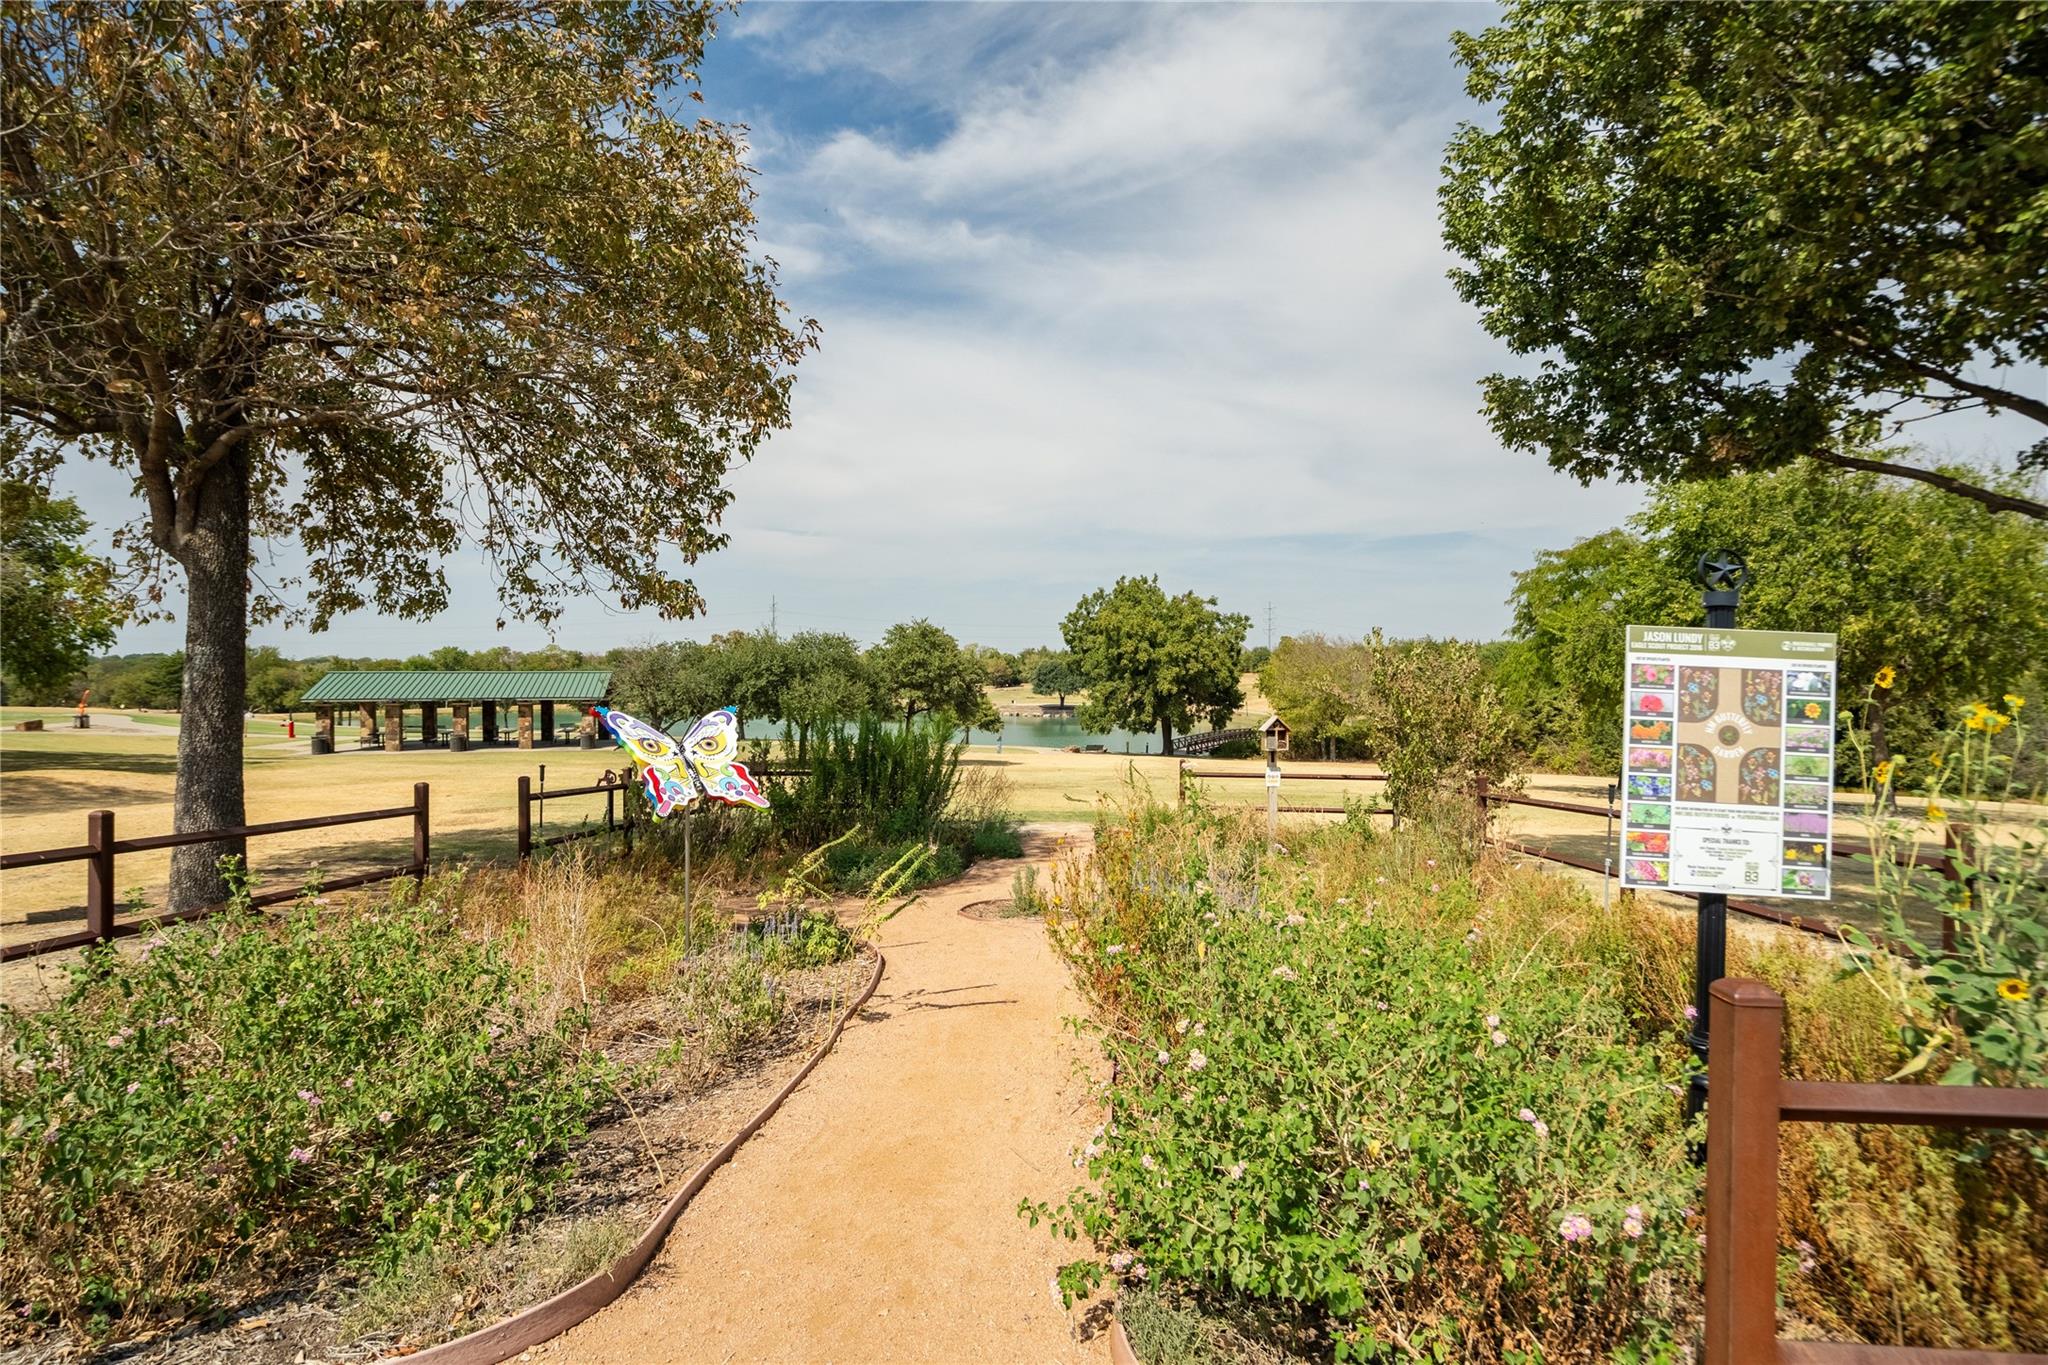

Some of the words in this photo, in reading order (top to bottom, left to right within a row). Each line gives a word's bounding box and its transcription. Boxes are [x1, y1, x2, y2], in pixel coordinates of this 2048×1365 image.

[1643, 631, 1672, 642] JASON
[1673, 632, 1703, 643] LUNDY
[1712, 745, 1745, 758] GARDEN
[1744, 871, 1759, 882] 83
